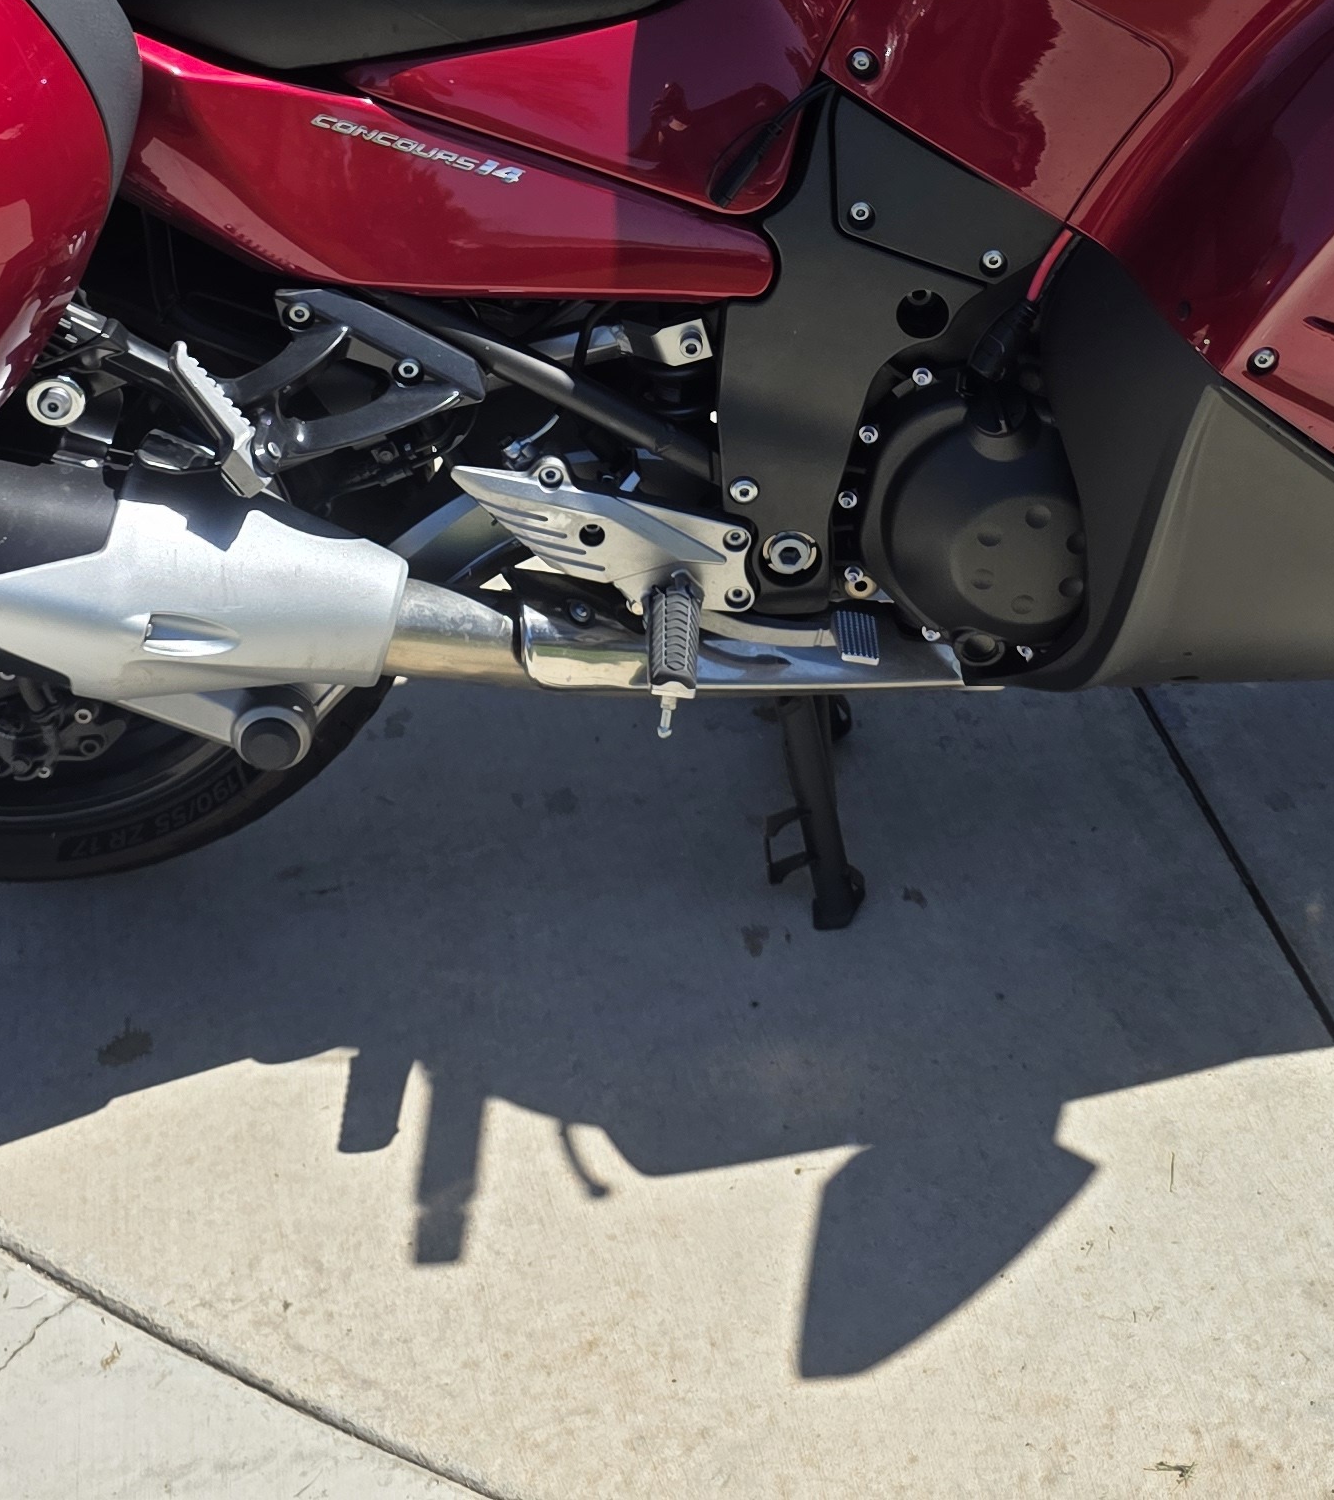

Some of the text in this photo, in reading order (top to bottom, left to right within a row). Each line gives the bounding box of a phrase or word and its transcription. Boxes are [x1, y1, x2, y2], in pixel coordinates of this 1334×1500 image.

[71, 773, 239, 858] 190/55 ZR 17
